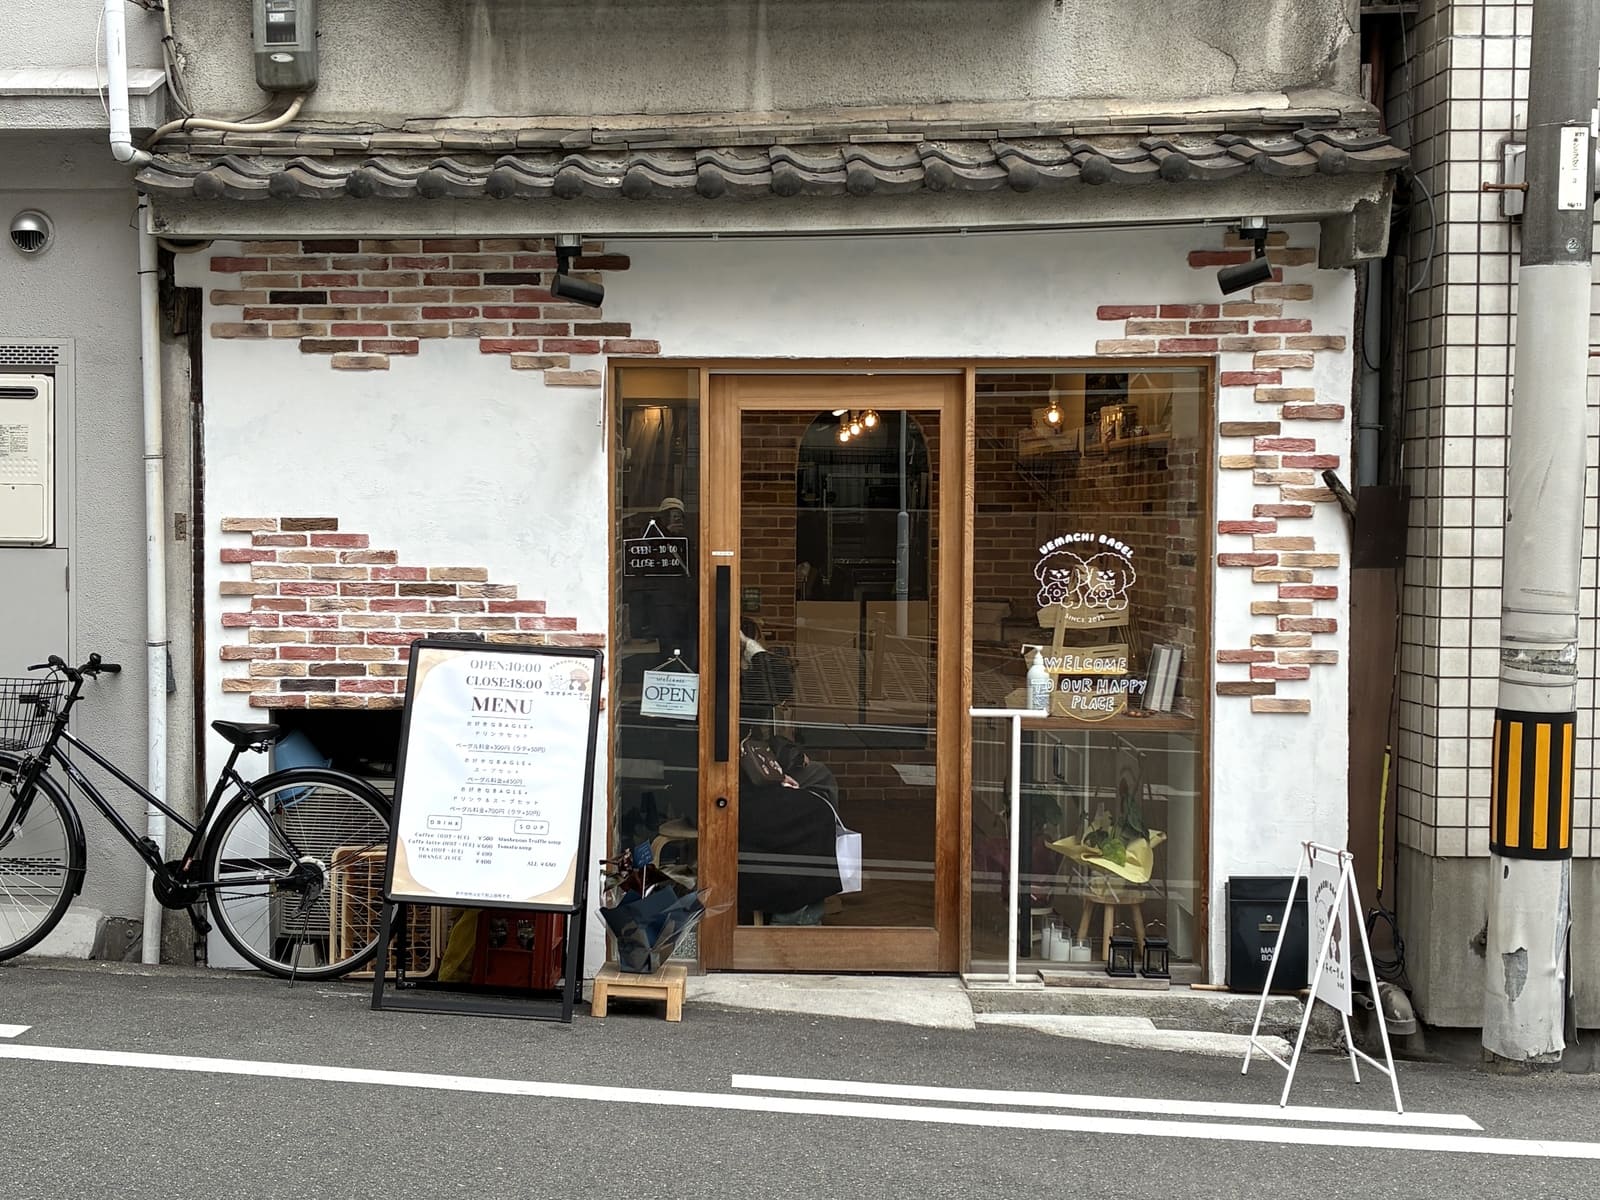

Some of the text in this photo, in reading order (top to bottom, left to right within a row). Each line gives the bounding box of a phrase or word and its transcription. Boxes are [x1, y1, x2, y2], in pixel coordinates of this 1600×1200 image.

[1039, 533, 1133, 559] UEMACHI BAGEL
[470, 659, 542, 673] OPEN:10:00
[1044, 655, 1128, 673] WELCOME
[465, 675, 543, 690] CLOSE:18:00
[1061, 678, 1093, 694] OUR
[1096, 679, 1147, 695] HAPPY
[645, 685, 697, 703] OPEN
[471, 696, 534, 715] MENU
[1071, 695, 1115, 712] PLACE
[1260, 946, 1275, 954] MAI
[1261, 954, 1273, 962] BO
